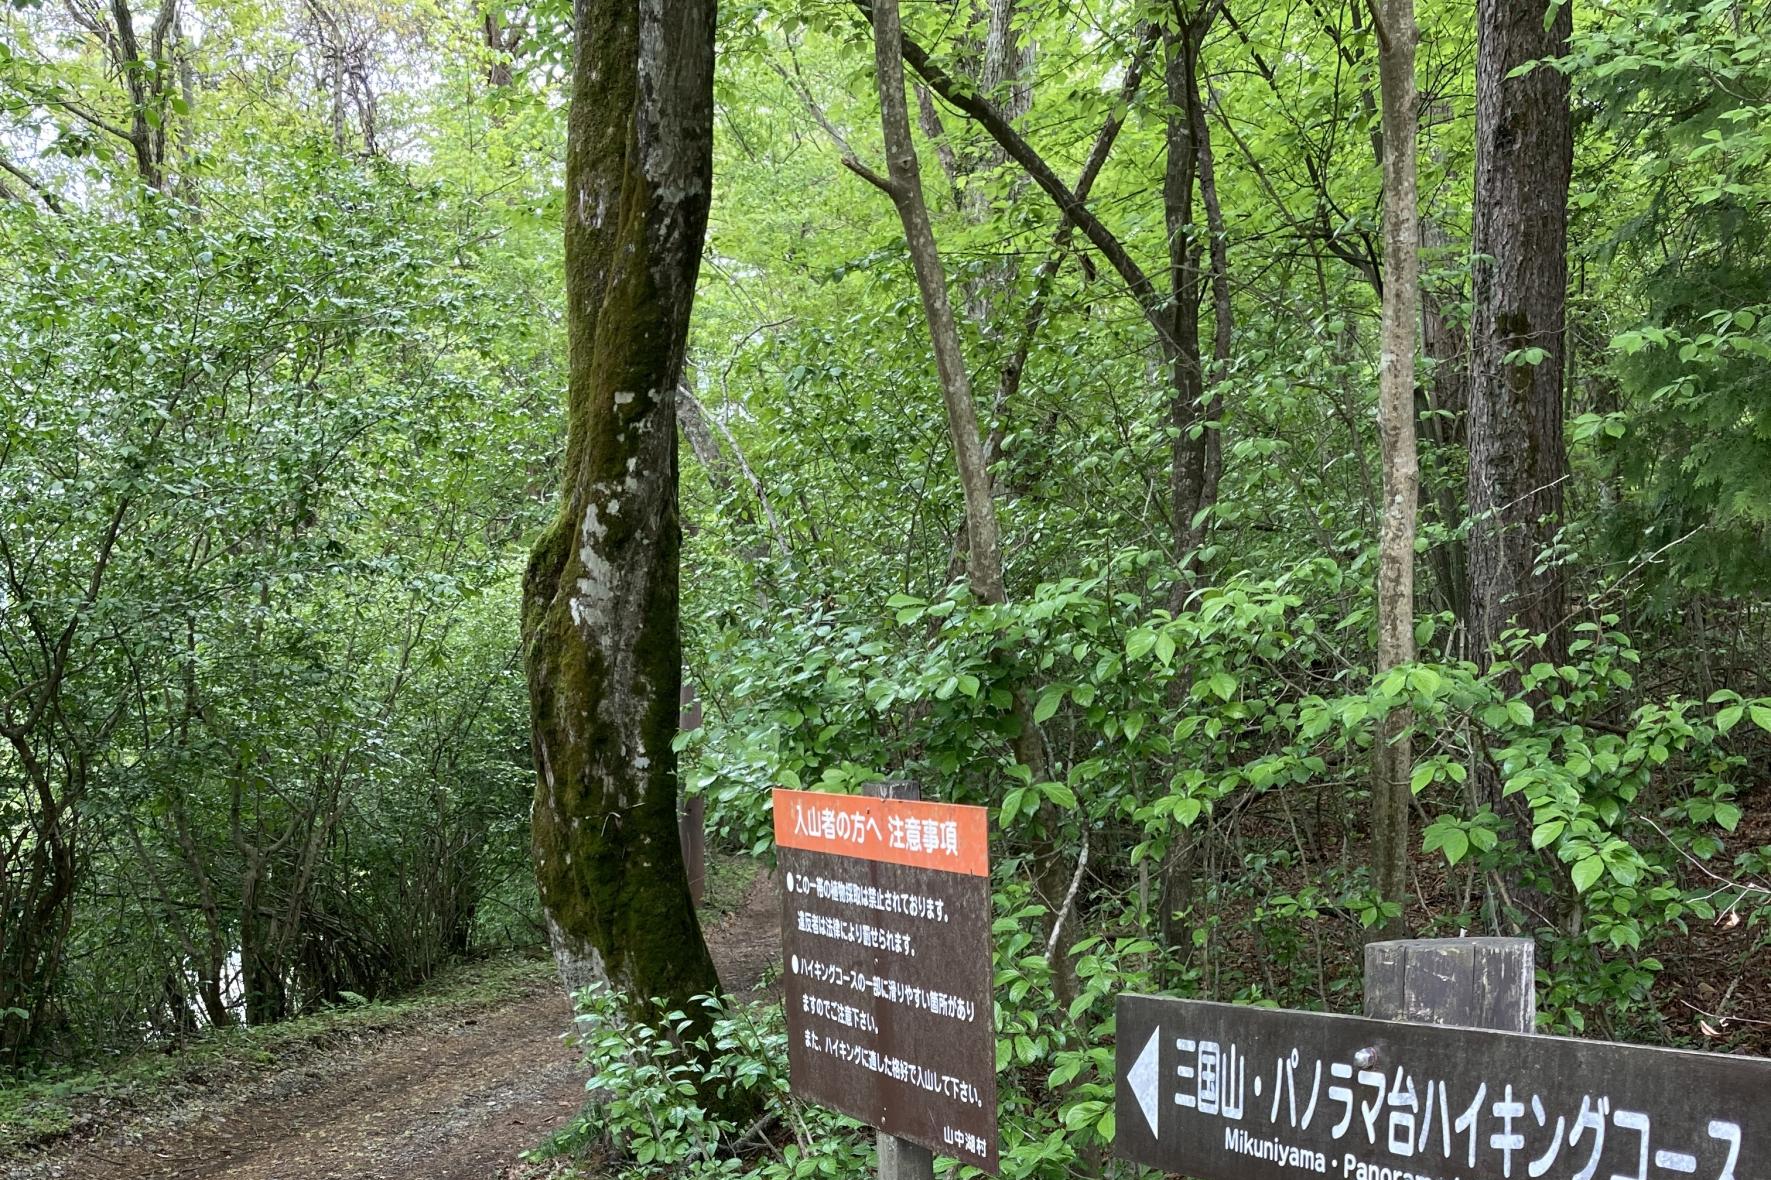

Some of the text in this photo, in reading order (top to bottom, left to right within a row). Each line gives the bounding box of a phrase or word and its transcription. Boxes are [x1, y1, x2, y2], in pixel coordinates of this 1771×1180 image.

[794, 805, 959, 857] 入山者の方へ 注意事項
[802, 993, 879, 1035] ますのでご注意下さい。
[943, 1125, 987, 1158] 山中湖村
[1224, 1126, 1326, 1175] Mikuniyama
